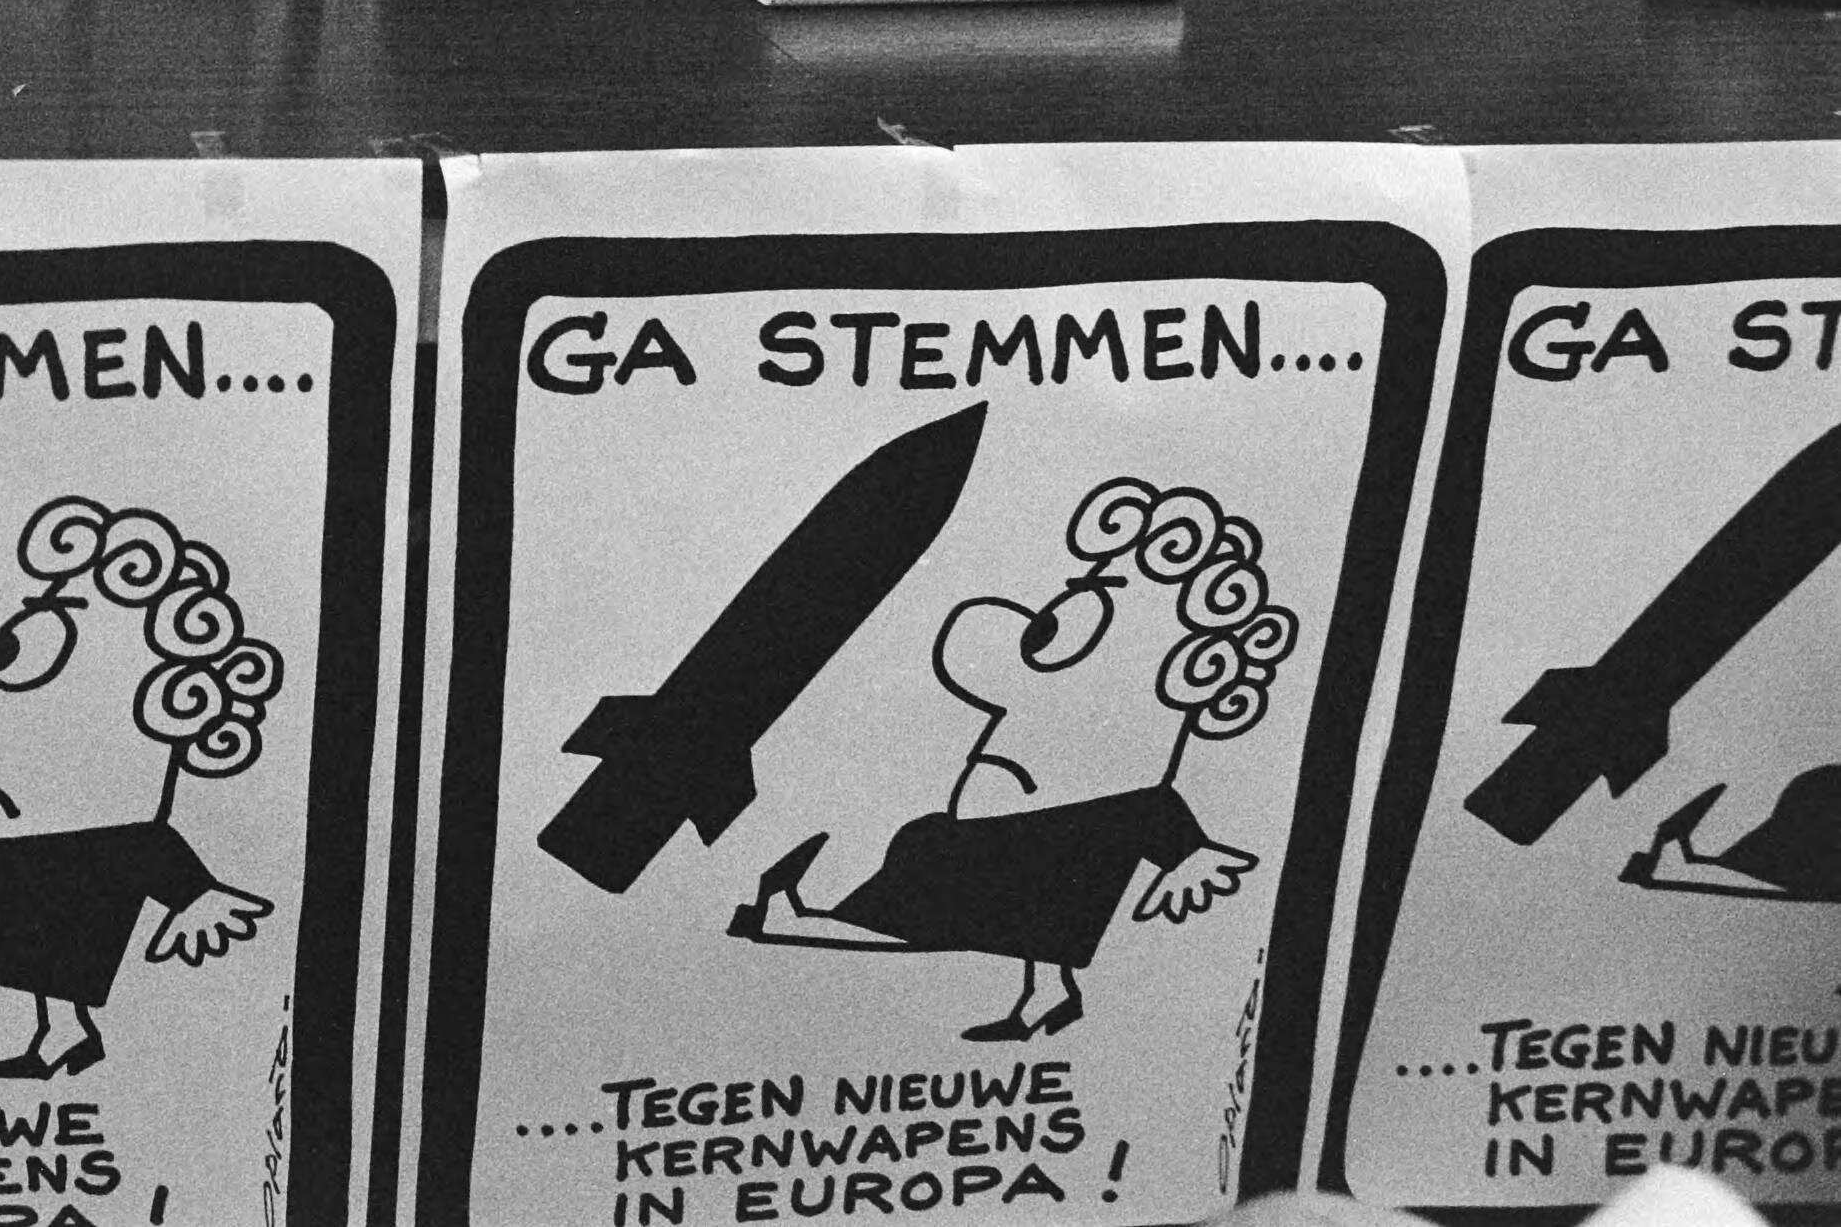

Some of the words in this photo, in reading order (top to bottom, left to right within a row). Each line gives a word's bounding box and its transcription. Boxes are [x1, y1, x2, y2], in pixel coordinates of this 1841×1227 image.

[526, 311, 697, 394] GA
[1508, 302, 1670, 381] GA
[1704, 1022, 1840, 1067] NIEU
[834, 1061, 1075, 1116] NIEUWE
[616, 1108, 1085, 1180] KERNWAPENS
[1484, 1133, 1555, 1178] IN
[613, 1187, 685, 1227] IN
